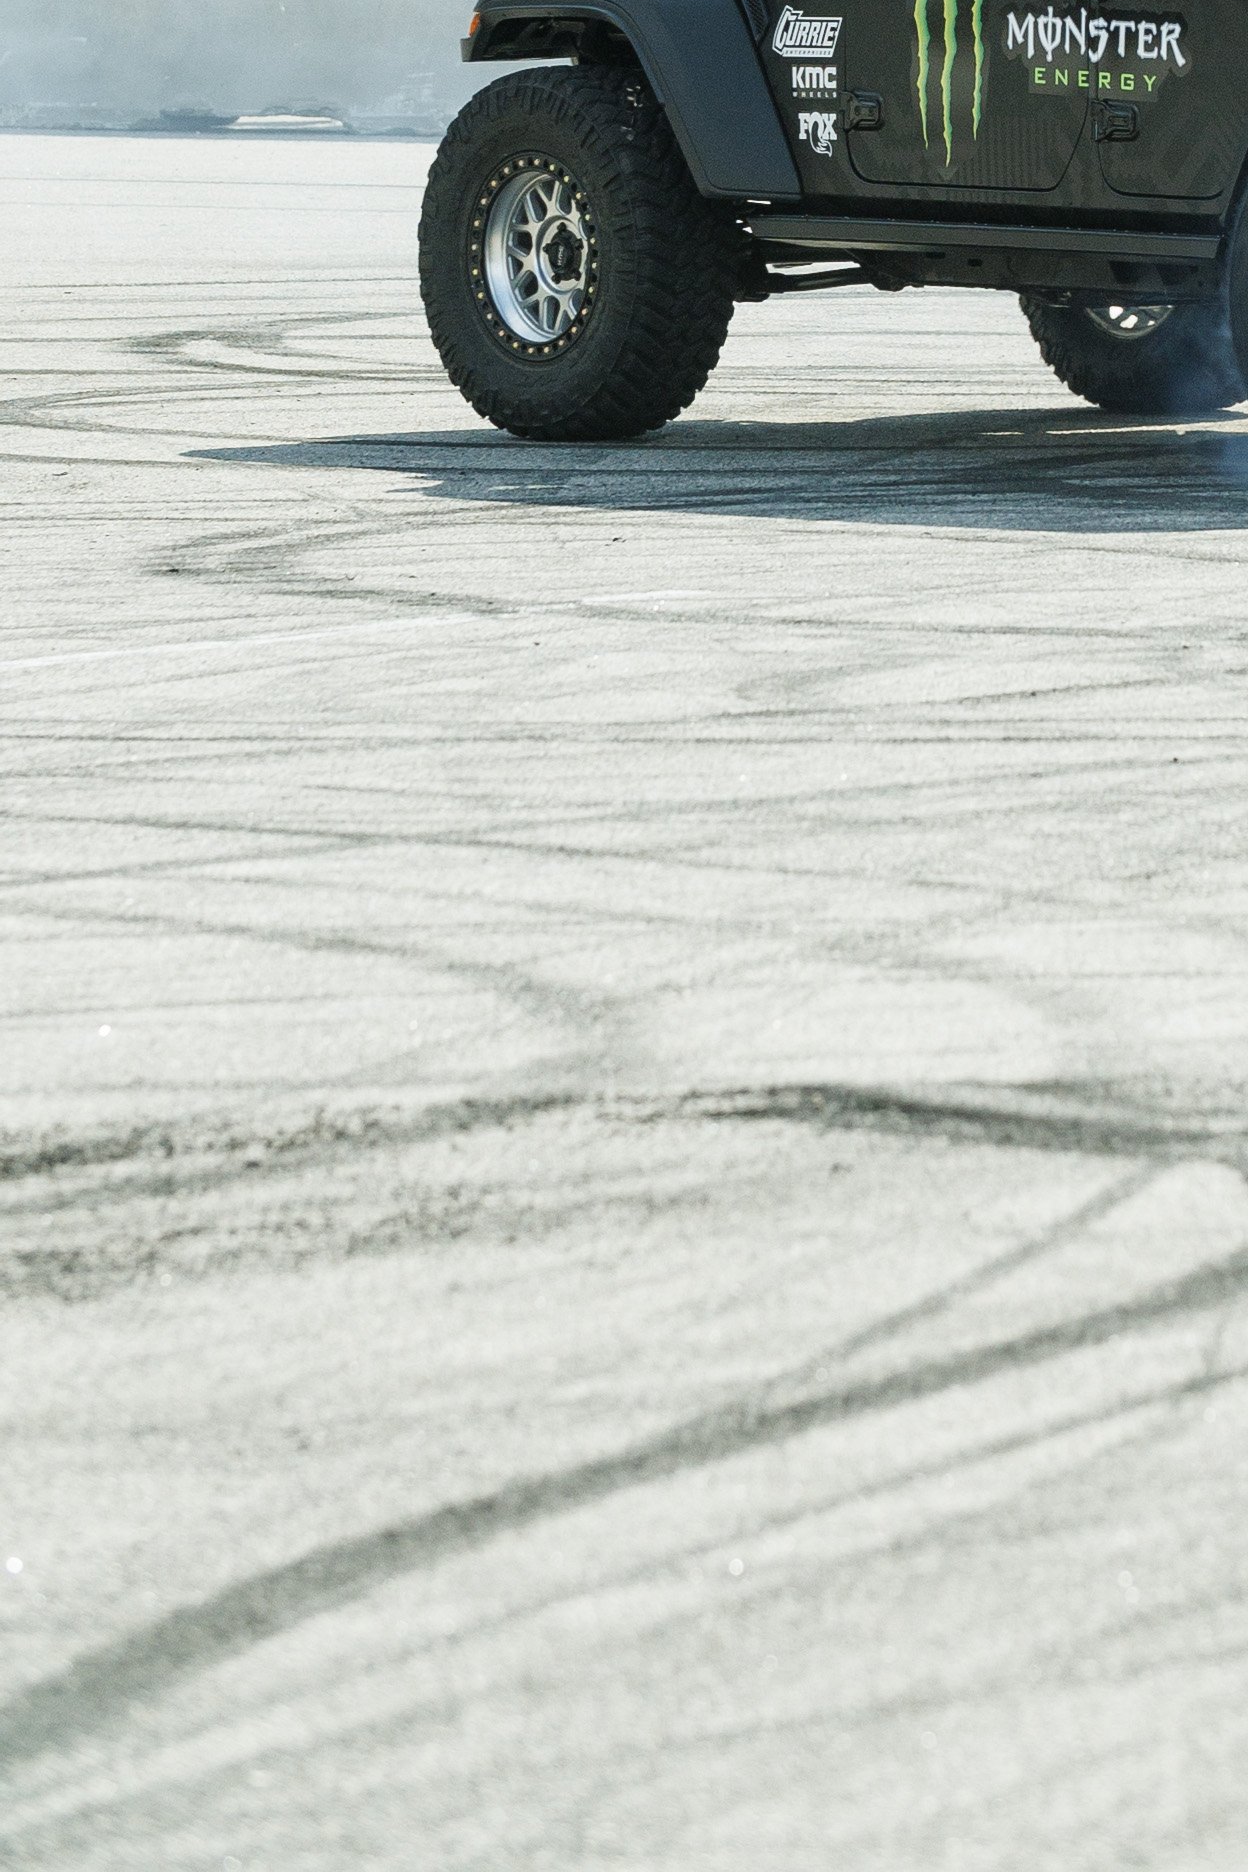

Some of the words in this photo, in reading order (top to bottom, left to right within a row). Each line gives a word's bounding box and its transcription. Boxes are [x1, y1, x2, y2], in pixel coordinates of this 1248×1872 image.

[775, 11, 838, 49] CURRIE
[1006, 6, 1186, 67] MONSTER
[791, 66, 837, 89] KMC
[1034, 67, 1158, 92] ENERGY
[798, 112, 837, 155] FOX
